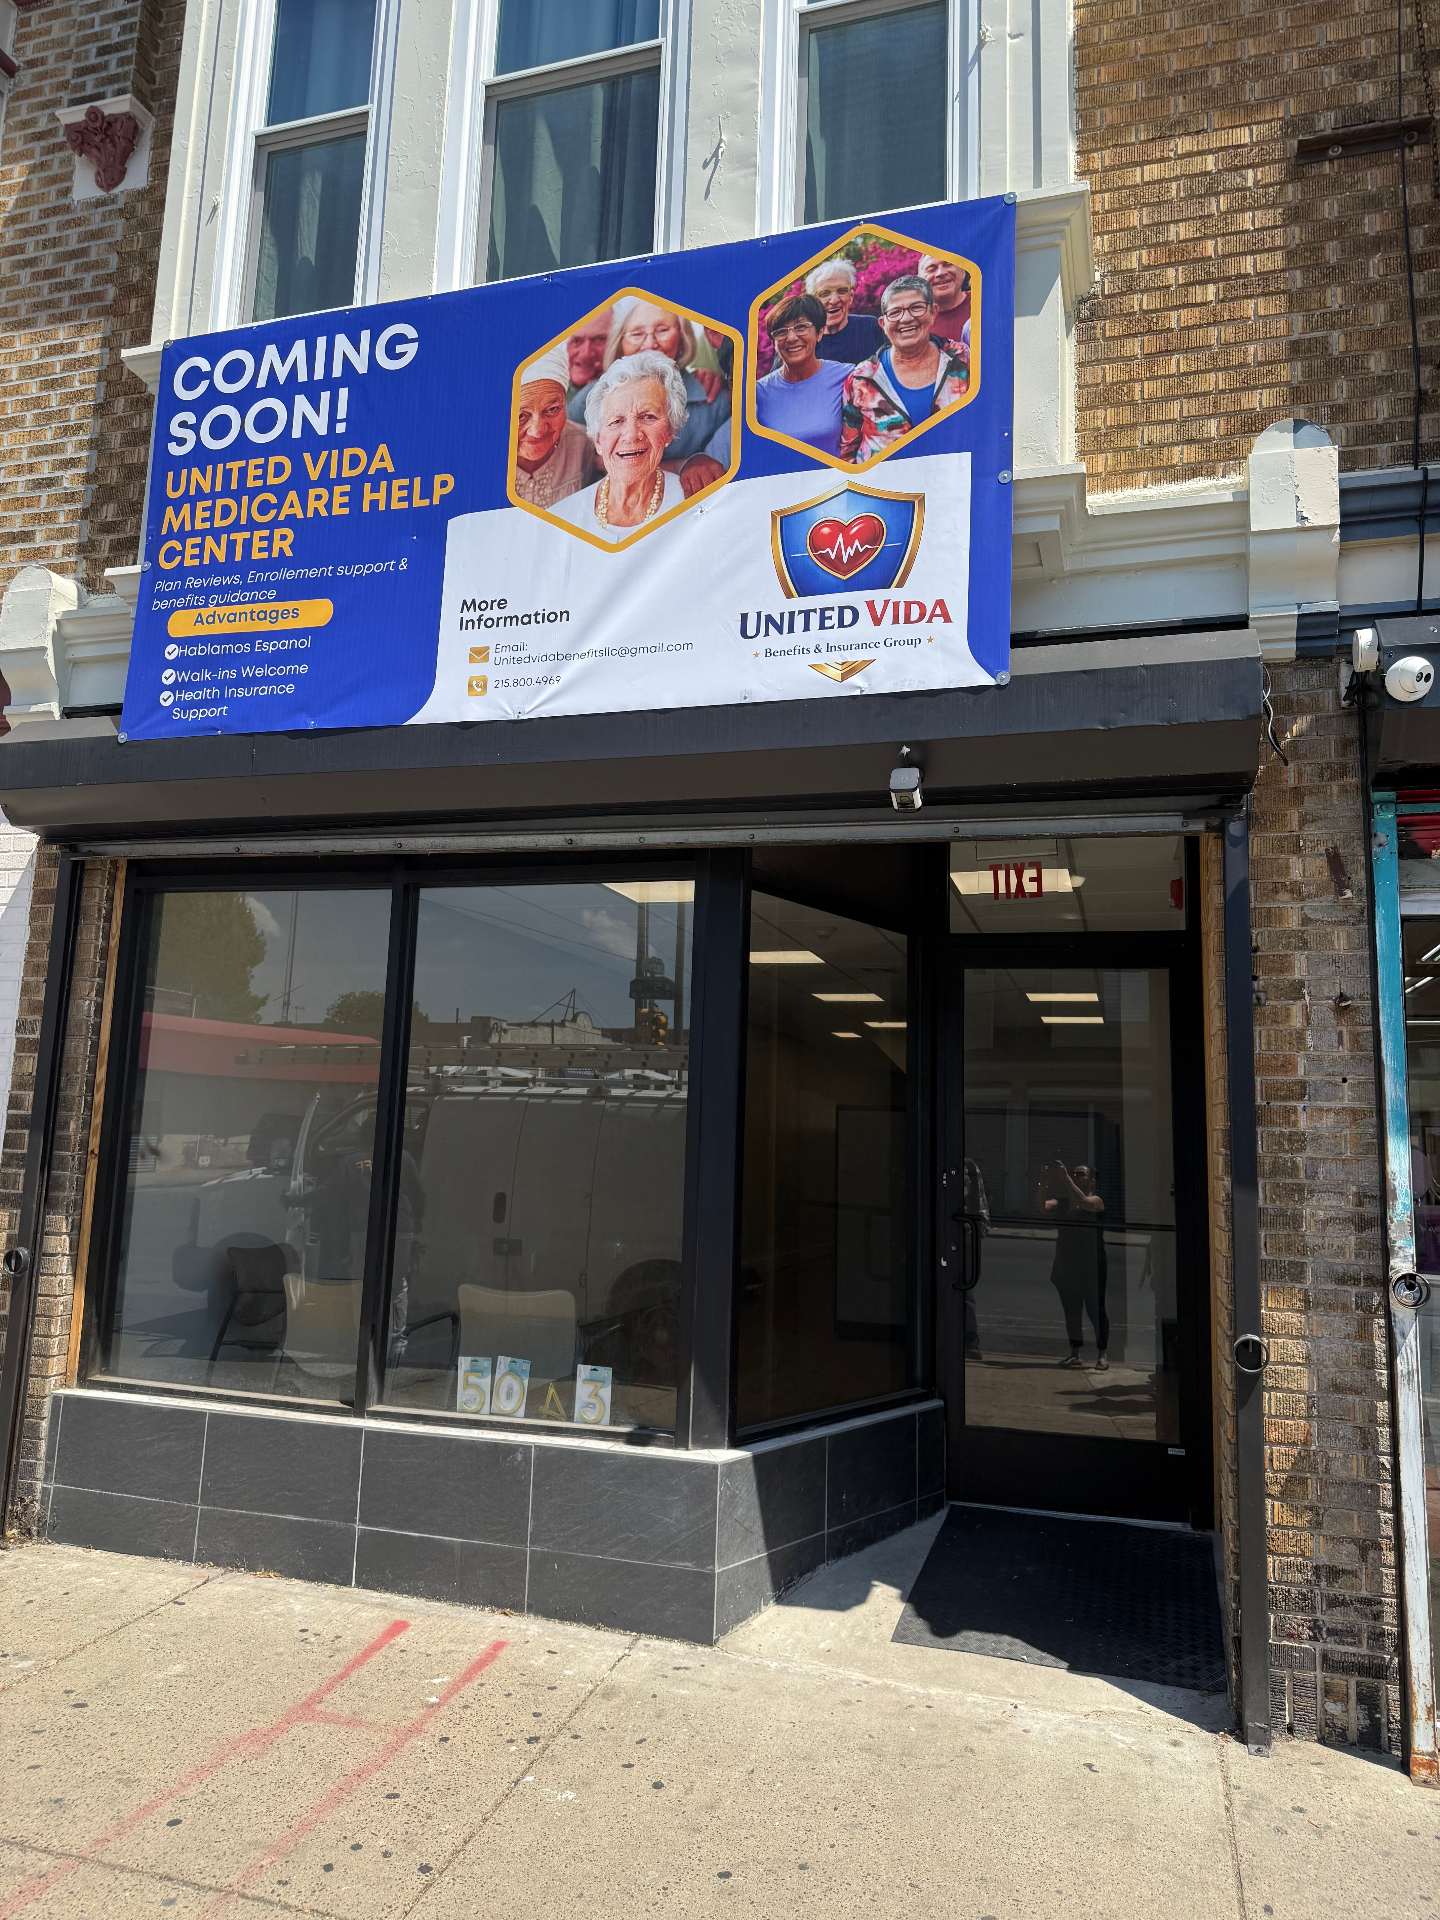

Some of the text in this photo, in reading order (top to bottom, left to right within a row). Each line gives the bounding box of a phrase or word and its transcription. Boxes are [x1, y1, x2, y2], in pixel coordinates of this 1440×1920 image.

[173, 323, 419, 401] COMING
[167, 387, 349, 456] SOON!
[166, 444, 395, 499] UNITED VIDA
[161, 474, 455, 535] MEDICARE HELP
[158, 528, 294, 570] CENTER
[153, 557, 408, 593] Plan Reviews, Enrollement support &
[152, 588, 277, 611] benefits guidance
[460, 598, 508, 614] More
[193, 605, 300, 626] Advantages
[459, 609, 570, 631] Information
[739, 598, 954, 640] UNITED VIDA
[178, 636, 312, 657] Hablamos Espanol
[494, 642, 528, 654] Email:
[494, 642, 694, 666] Unitedvidabenefitsllc@gmail.com
[764, 636, 922, 658] Benefits & Insurance Group
[177, 664, 309, 683] Walk-ins Welcome
[175, 683, 295, 702] Health Insurance
[172, 706, 228, 721] Support
